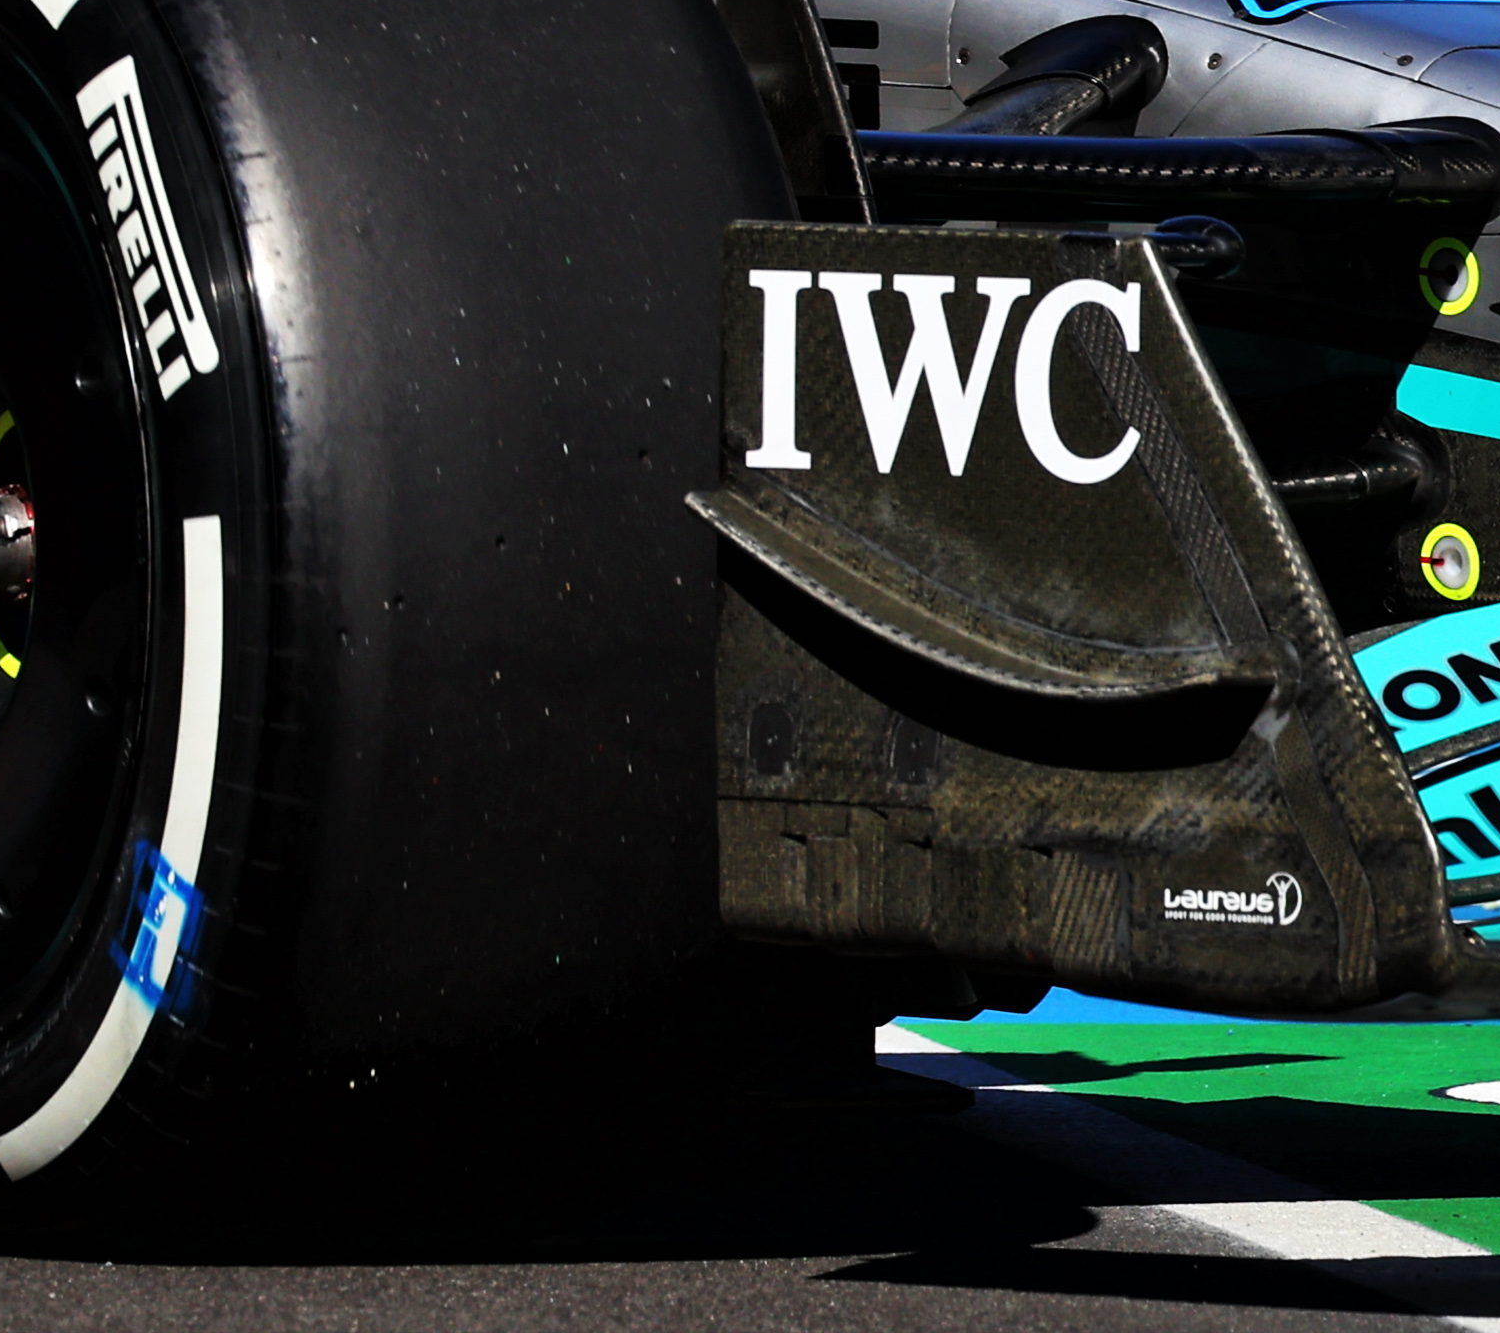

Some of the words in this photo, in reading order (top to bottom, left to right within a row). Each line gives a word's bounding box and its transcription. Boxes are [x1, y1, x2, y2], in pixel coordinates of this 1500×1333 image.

[75, 54, 220, 402] PIRELLI
[743, 267, 1142, 484] IWC
[1163, 887, 1275, 914] Laureus
